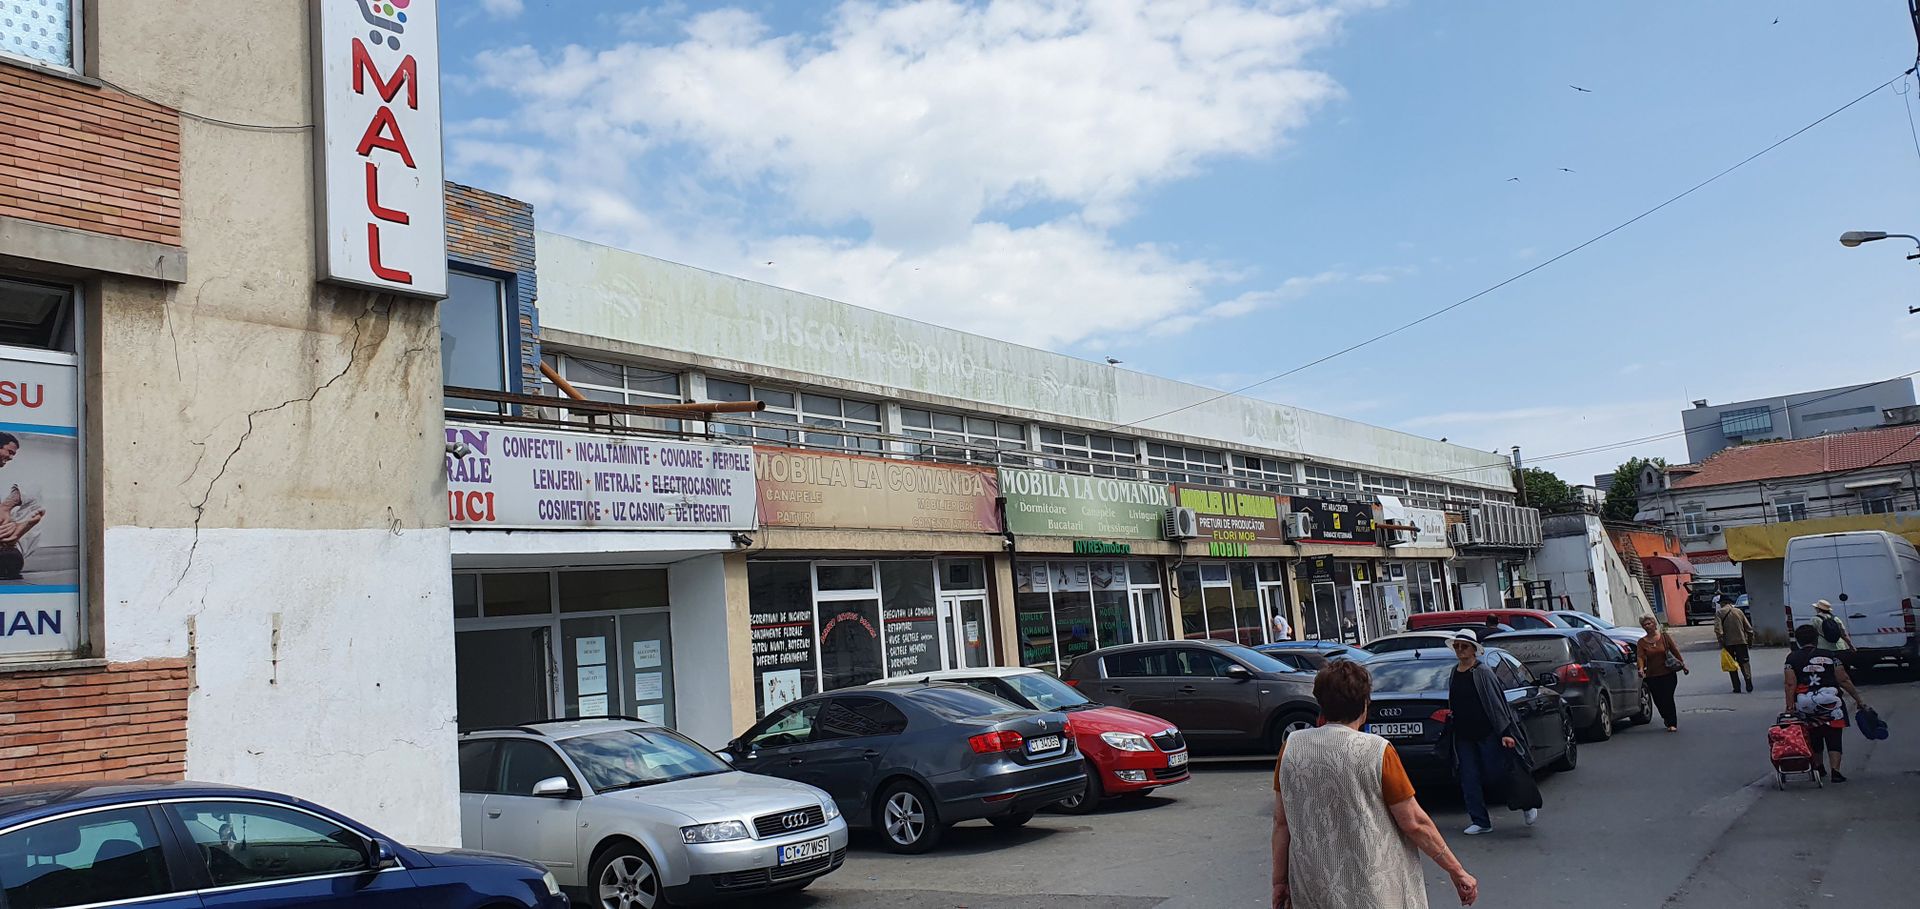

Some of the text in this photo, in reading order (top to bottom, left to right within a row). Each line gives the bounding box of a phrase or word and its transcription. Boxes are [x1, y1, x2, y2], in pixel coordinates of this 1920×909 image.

[352, 37, 418, 285] MALL
[503, 436, 750, 472] CONFECTII INCALTAMINTE COVOARE PERDELE
[753, 452, 986, 497] MOBILA LA COMANDA
[533, 469, 732, 497] LENJERII METRAJE ELECTROCASNICE
[1001, 469, 1169, 507] MOBILA LA COMANDA
[766, 489, 823, 503] CANAPELE
[448, 491, 496, 521] ICI
[539, 500, 731, 523] COSMETICE UZ CASNIC DETERGENTI
[1020, 502, 1067, 514] Dormitoare
[776, 510, 816, 525] PATURI
[1223, 519, 1231, 529] DE
[1213, 530, 1256, 541] FLORI MOB
[1208, 541, 1249, 557] MOBILA
[780, 612, 787, 622] DE
[783, 626, 803, 638] FLORALE
